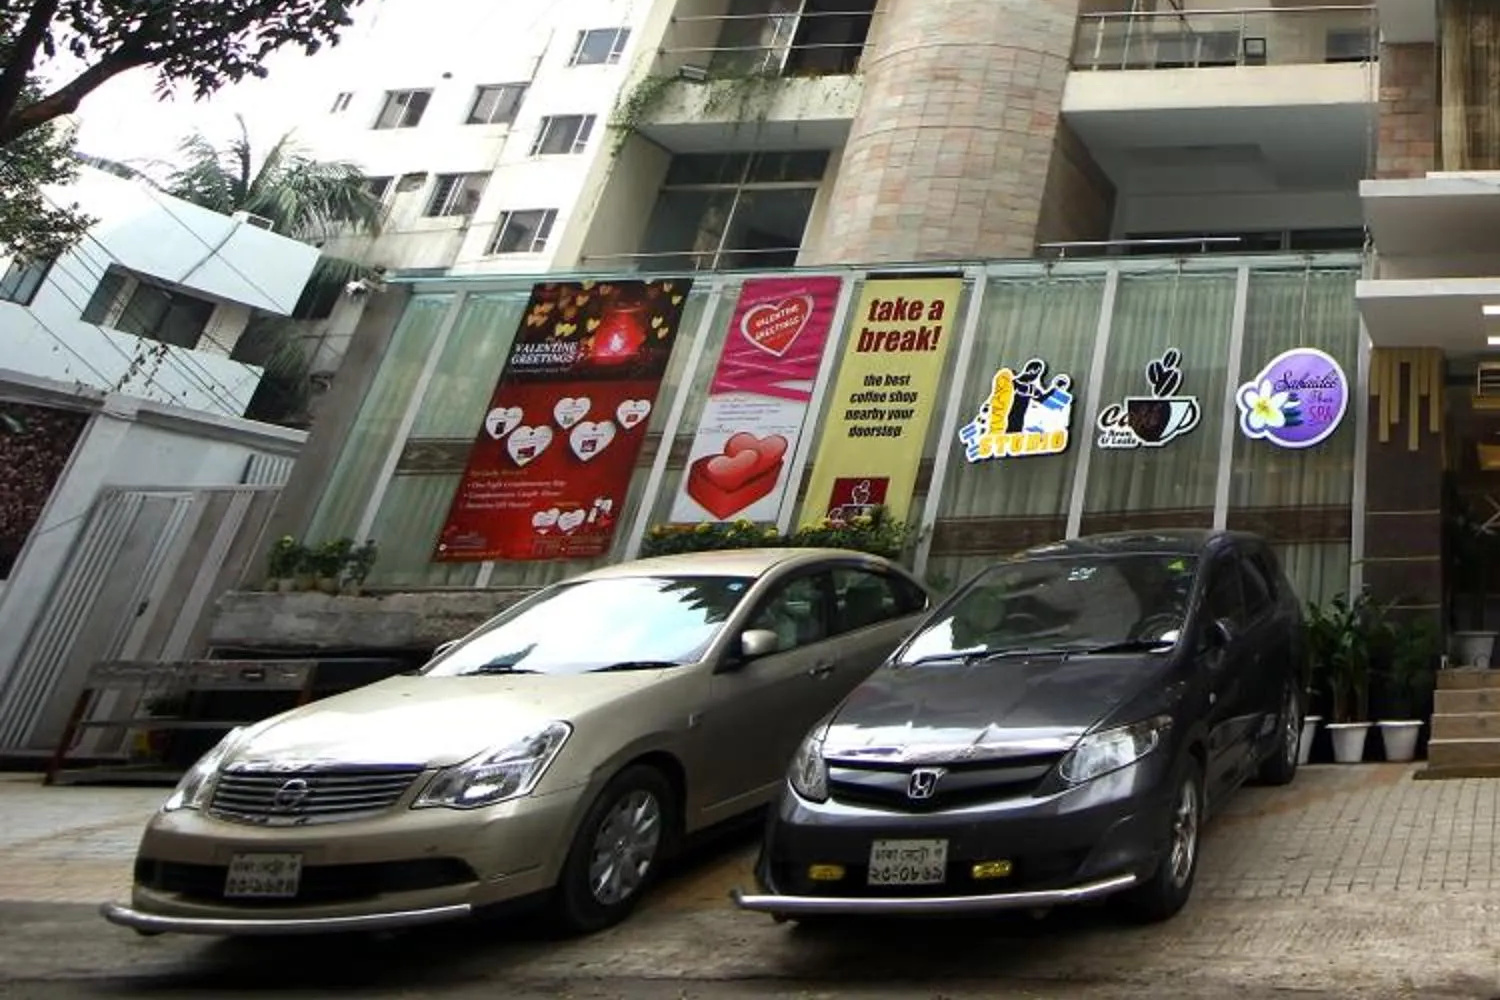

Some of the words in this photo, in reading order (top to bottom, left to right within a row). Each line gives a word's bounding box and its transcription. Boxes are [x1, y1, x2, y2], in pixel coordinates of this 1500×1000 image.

[755, 304, 800, 327] VALENTINE
[868, 297, 924, 322] take
[928, 299, 945, 321] a
[856, 326, 942, 353] break!
[515, 342, 577, 354] VALENTINE
[864, 374, 882, 386] the
[884, 374, 911, 386] best
[850, 391, 886, 403] coffee
[889, 391, 918, 404] shop
[845, 408, 885, 420] nearby
[887, 409, 914, 421] your
[1310, 405, 1333, 421] SPA
[848, 426, 902, 438] doorstep
[978, 430, 1065, 457] STUDIO
